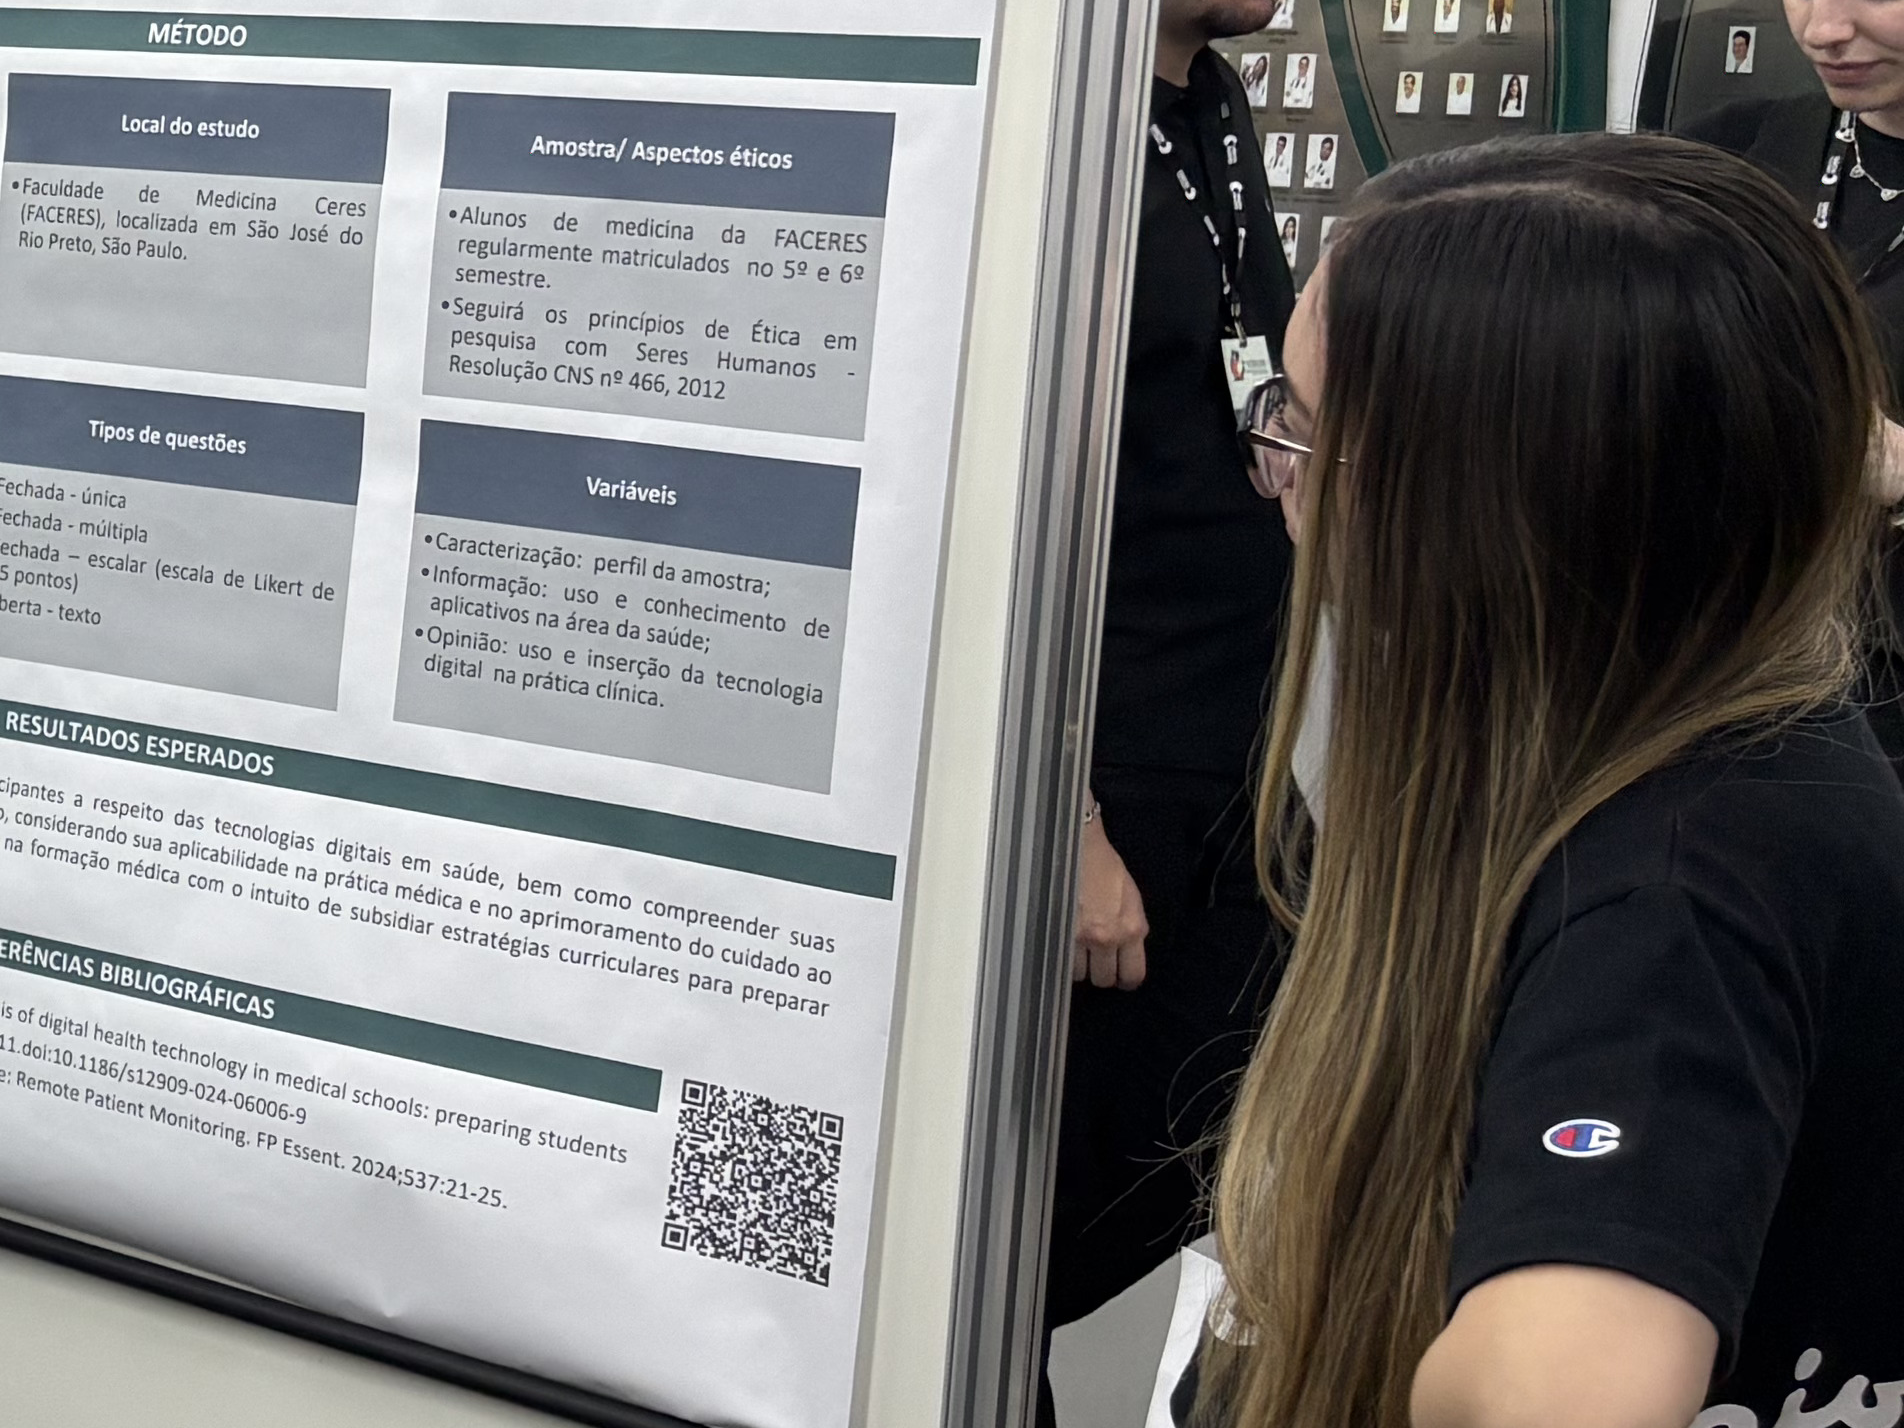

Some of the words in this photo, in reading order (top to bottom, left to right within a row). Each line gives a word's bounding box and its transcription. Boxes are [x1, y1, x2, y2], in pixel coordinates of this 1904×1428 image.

[148, 17, 248, 47] MÉTODO
[121, 114, 166, 134] Local
[169, 116, 193, 135] do
[197, 119, 260, 139] estudo
[530, 135, 628, 163] Amostra/
[631, 141, 725, 166] Aspectos
[729, 144, 793, 170] éticos
[22, 177, 104, 200] Faculdade
[138, 184, 160, 204] de
[196, 189, 277, 212] Medicina
[315, 196, 367, 218] Ceres
[20, 202, 106, 230] (FACERES),
[116, 209, 198, 234] localizada
[208, 221, 236, 237] em
[246, 219, 279, 240] São
[288, 223, 329, 244] José
[339, 225, 364, 246] do
[18, 230, 44, 249] Rio
[48, 232, 96, 256] Preto,
[101, 236, 132, 256] São
[136, 239, 187, 261] Paulo.
[88, 419, 135, 443] Tipos
[138, 424, 161, 445] de
[165, 432, 247, 455] questões
[586, 475, 677, 506] Variáveis
[5, 710, 140, 753] RESULTADOS
[145, 734, 275, 777] ESPERADOS
[100, 961, 275, 1020] BIBLIOGRÁFICAS
